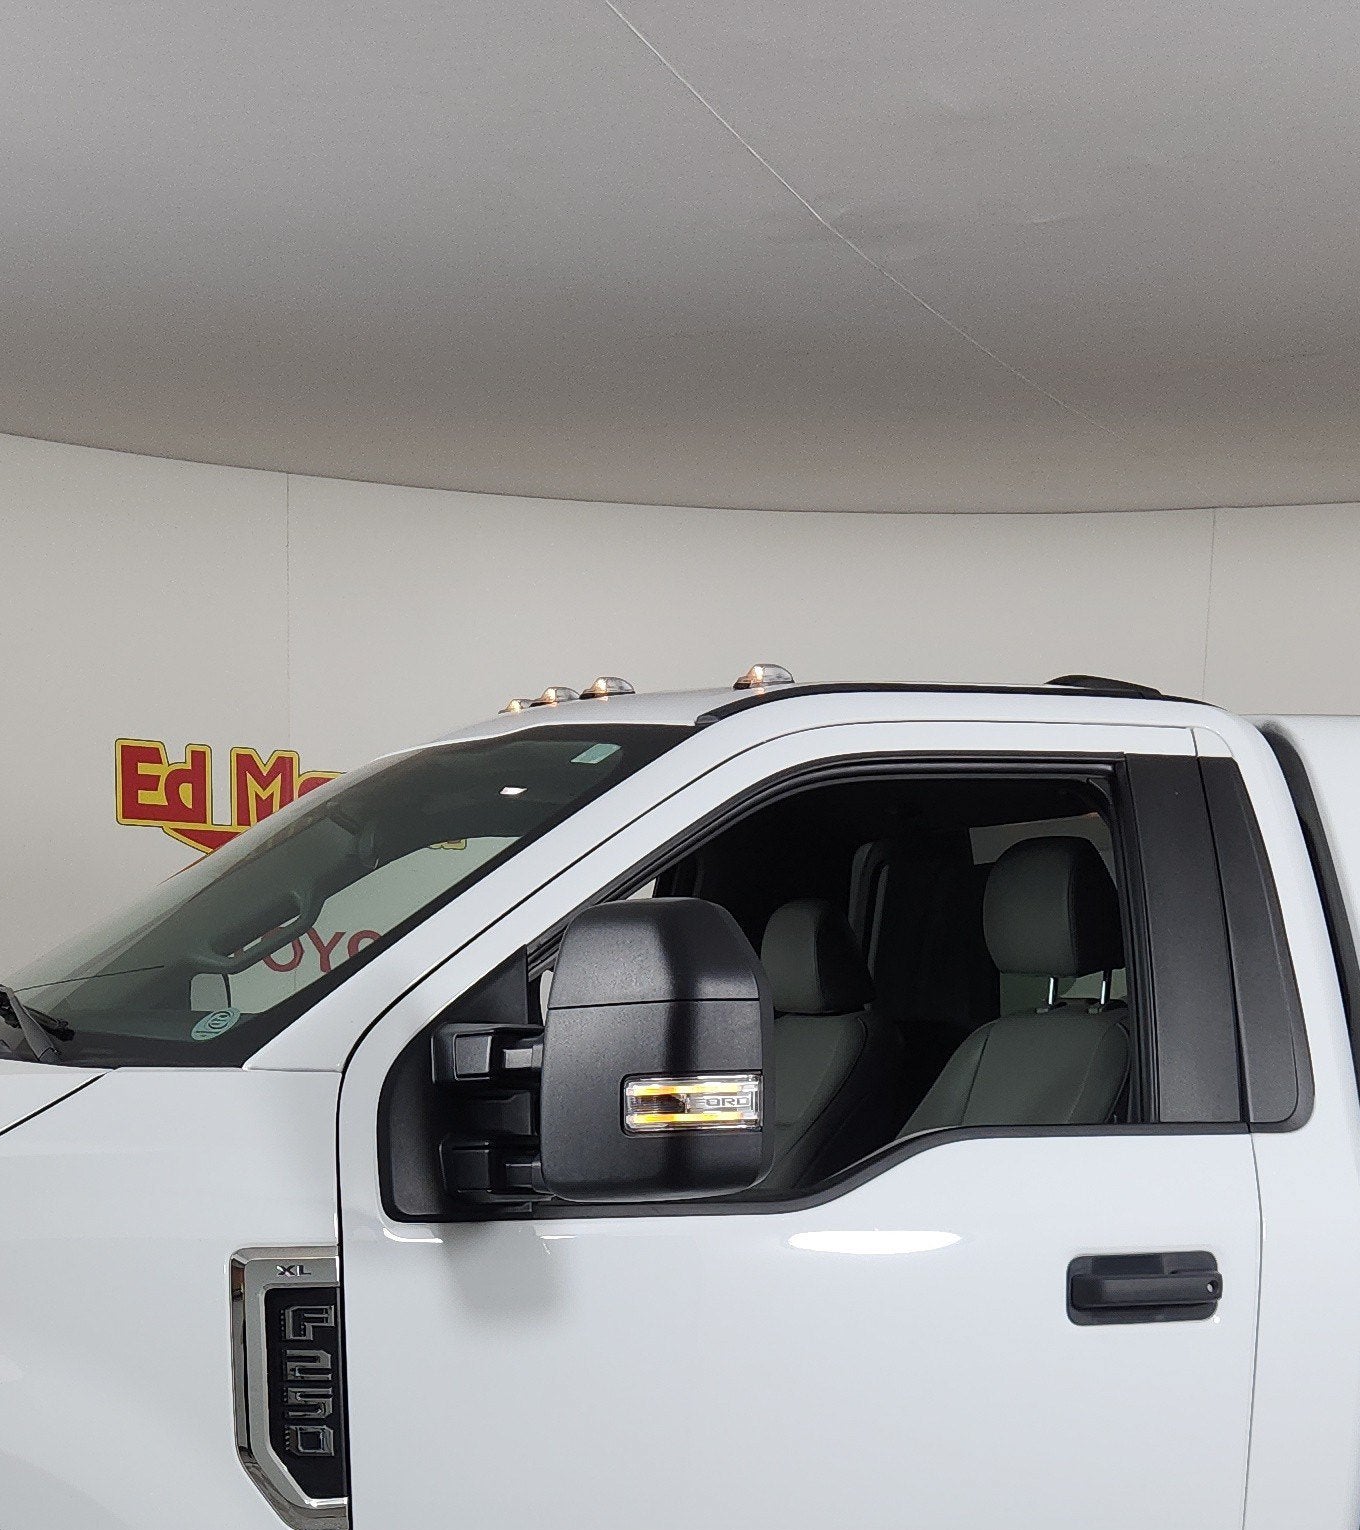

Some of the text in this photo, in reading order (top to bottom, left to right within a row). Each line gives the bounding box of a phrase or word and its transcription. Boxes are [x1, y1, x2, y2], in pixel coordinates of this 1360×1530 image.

[116, 739, 211, 826] Ed
[276, 1264, 311, 1277] XL
[281, 1304, 336, 1457] F250
